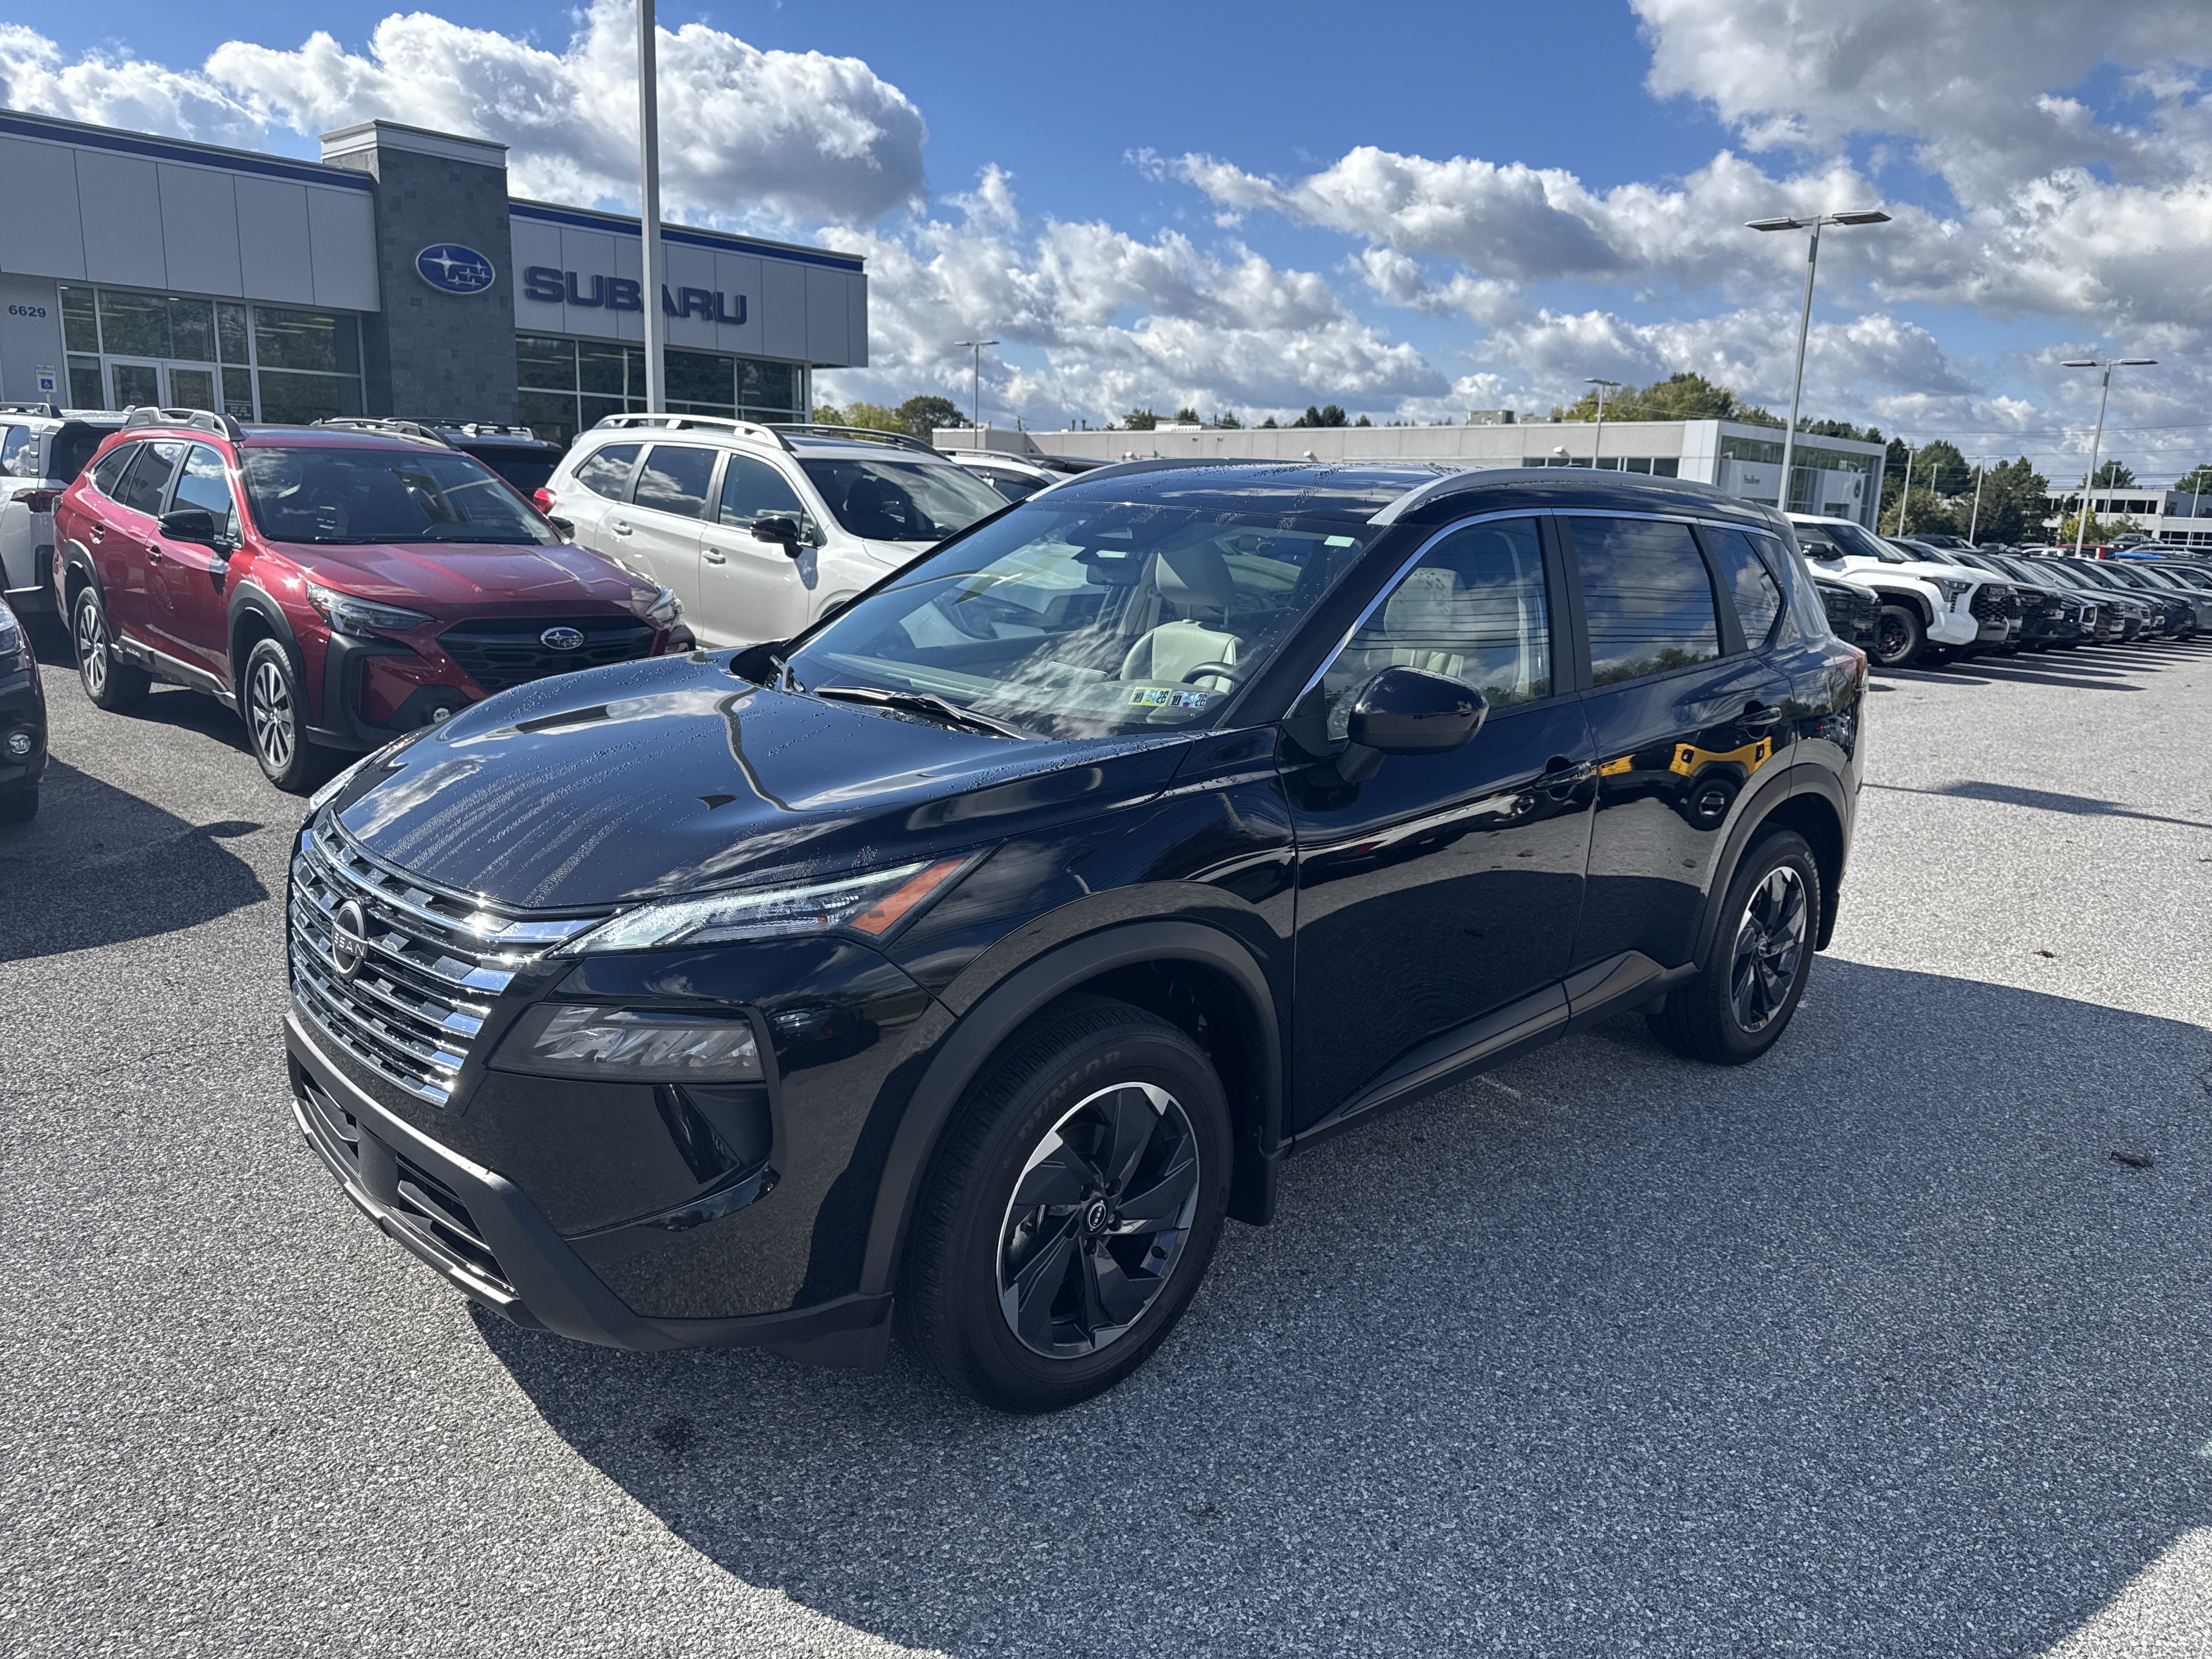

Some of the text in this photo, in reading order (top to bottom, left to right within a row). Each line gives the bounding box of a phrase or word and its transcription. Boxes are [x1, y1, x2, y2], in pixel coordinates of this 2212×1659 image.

[9, 305, 46, 318] 6629
[1133, 691, 1169, 704] 10 26
[1170, 693, 1207, 707] 10 26
[334, 932, 365, 956] SSAN
[1018, 1050, 1120, 1142] DUNLOP
